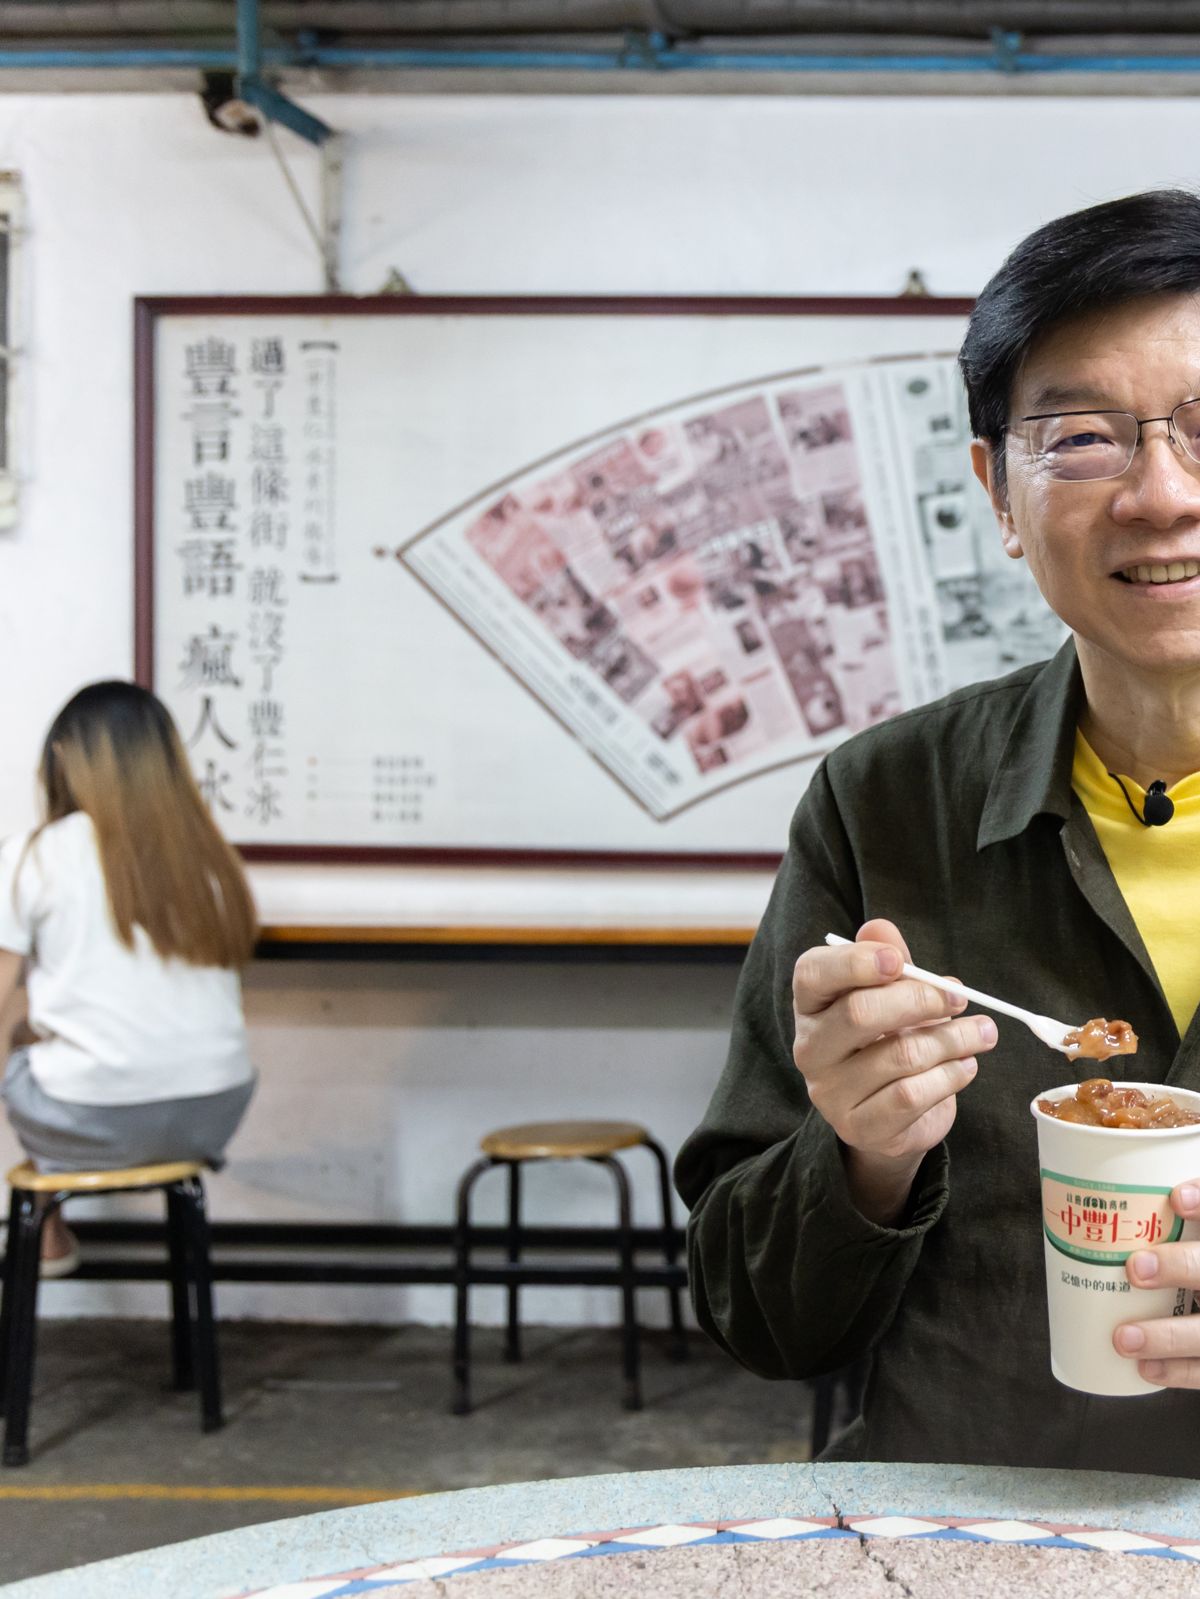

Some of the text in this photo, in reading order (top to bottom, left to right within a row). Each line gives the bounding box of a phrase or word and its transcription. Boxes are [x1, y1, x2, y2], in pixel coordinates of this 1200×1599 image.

[180, 333, 241, 598] 豐言豐語
[1061, 1270, 1131, 1292] 記憶中的味道
